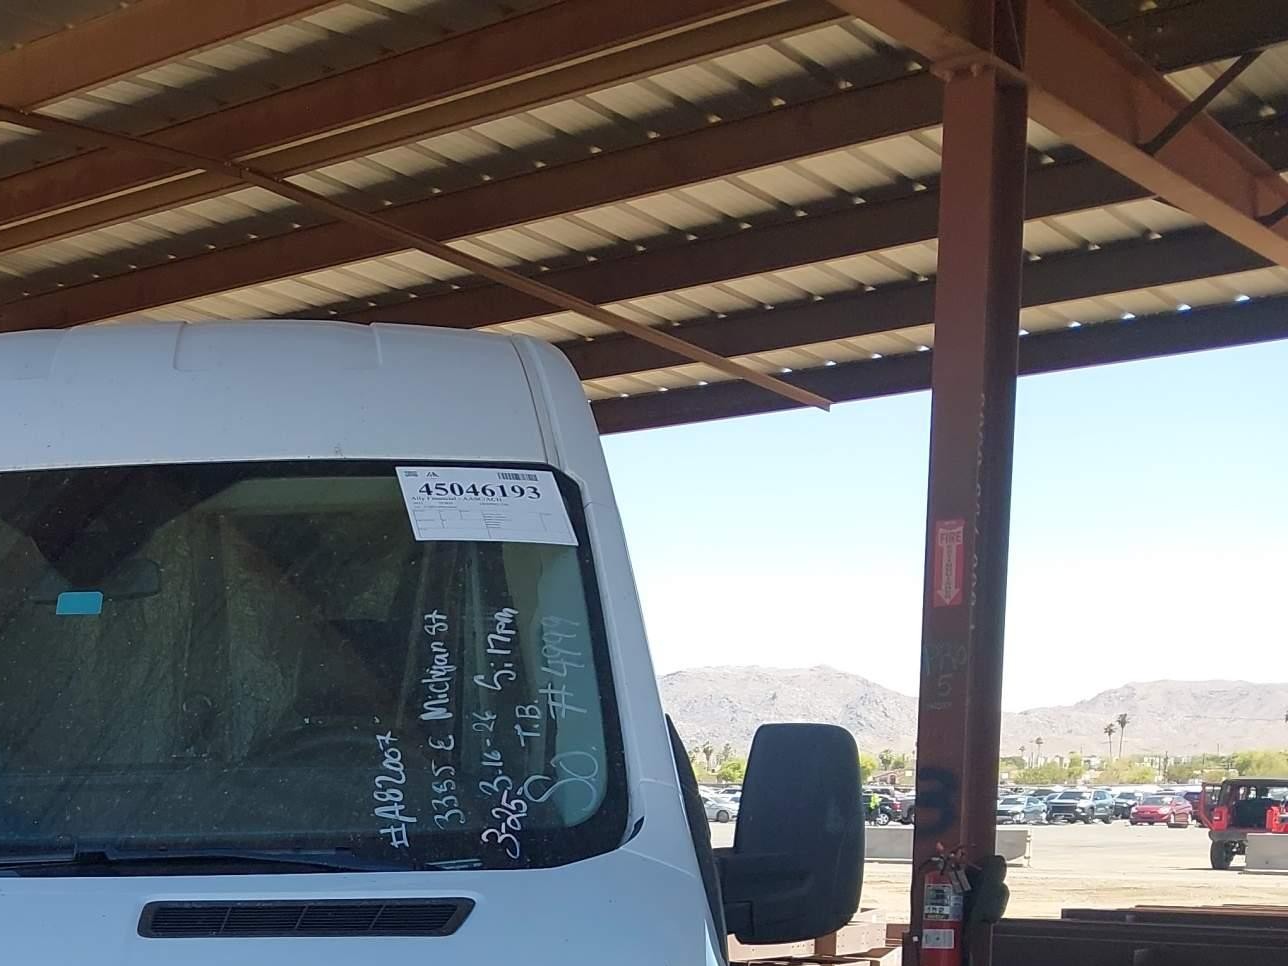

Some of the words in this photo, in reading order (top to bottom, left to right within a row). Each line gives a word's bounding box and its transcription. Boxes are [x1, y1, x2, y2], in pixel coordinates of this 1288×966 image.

[419, 482, 541, 499] 45046193
[939, 531, 962, 544] FIRE
[430, 760, 467, 831] 3355
